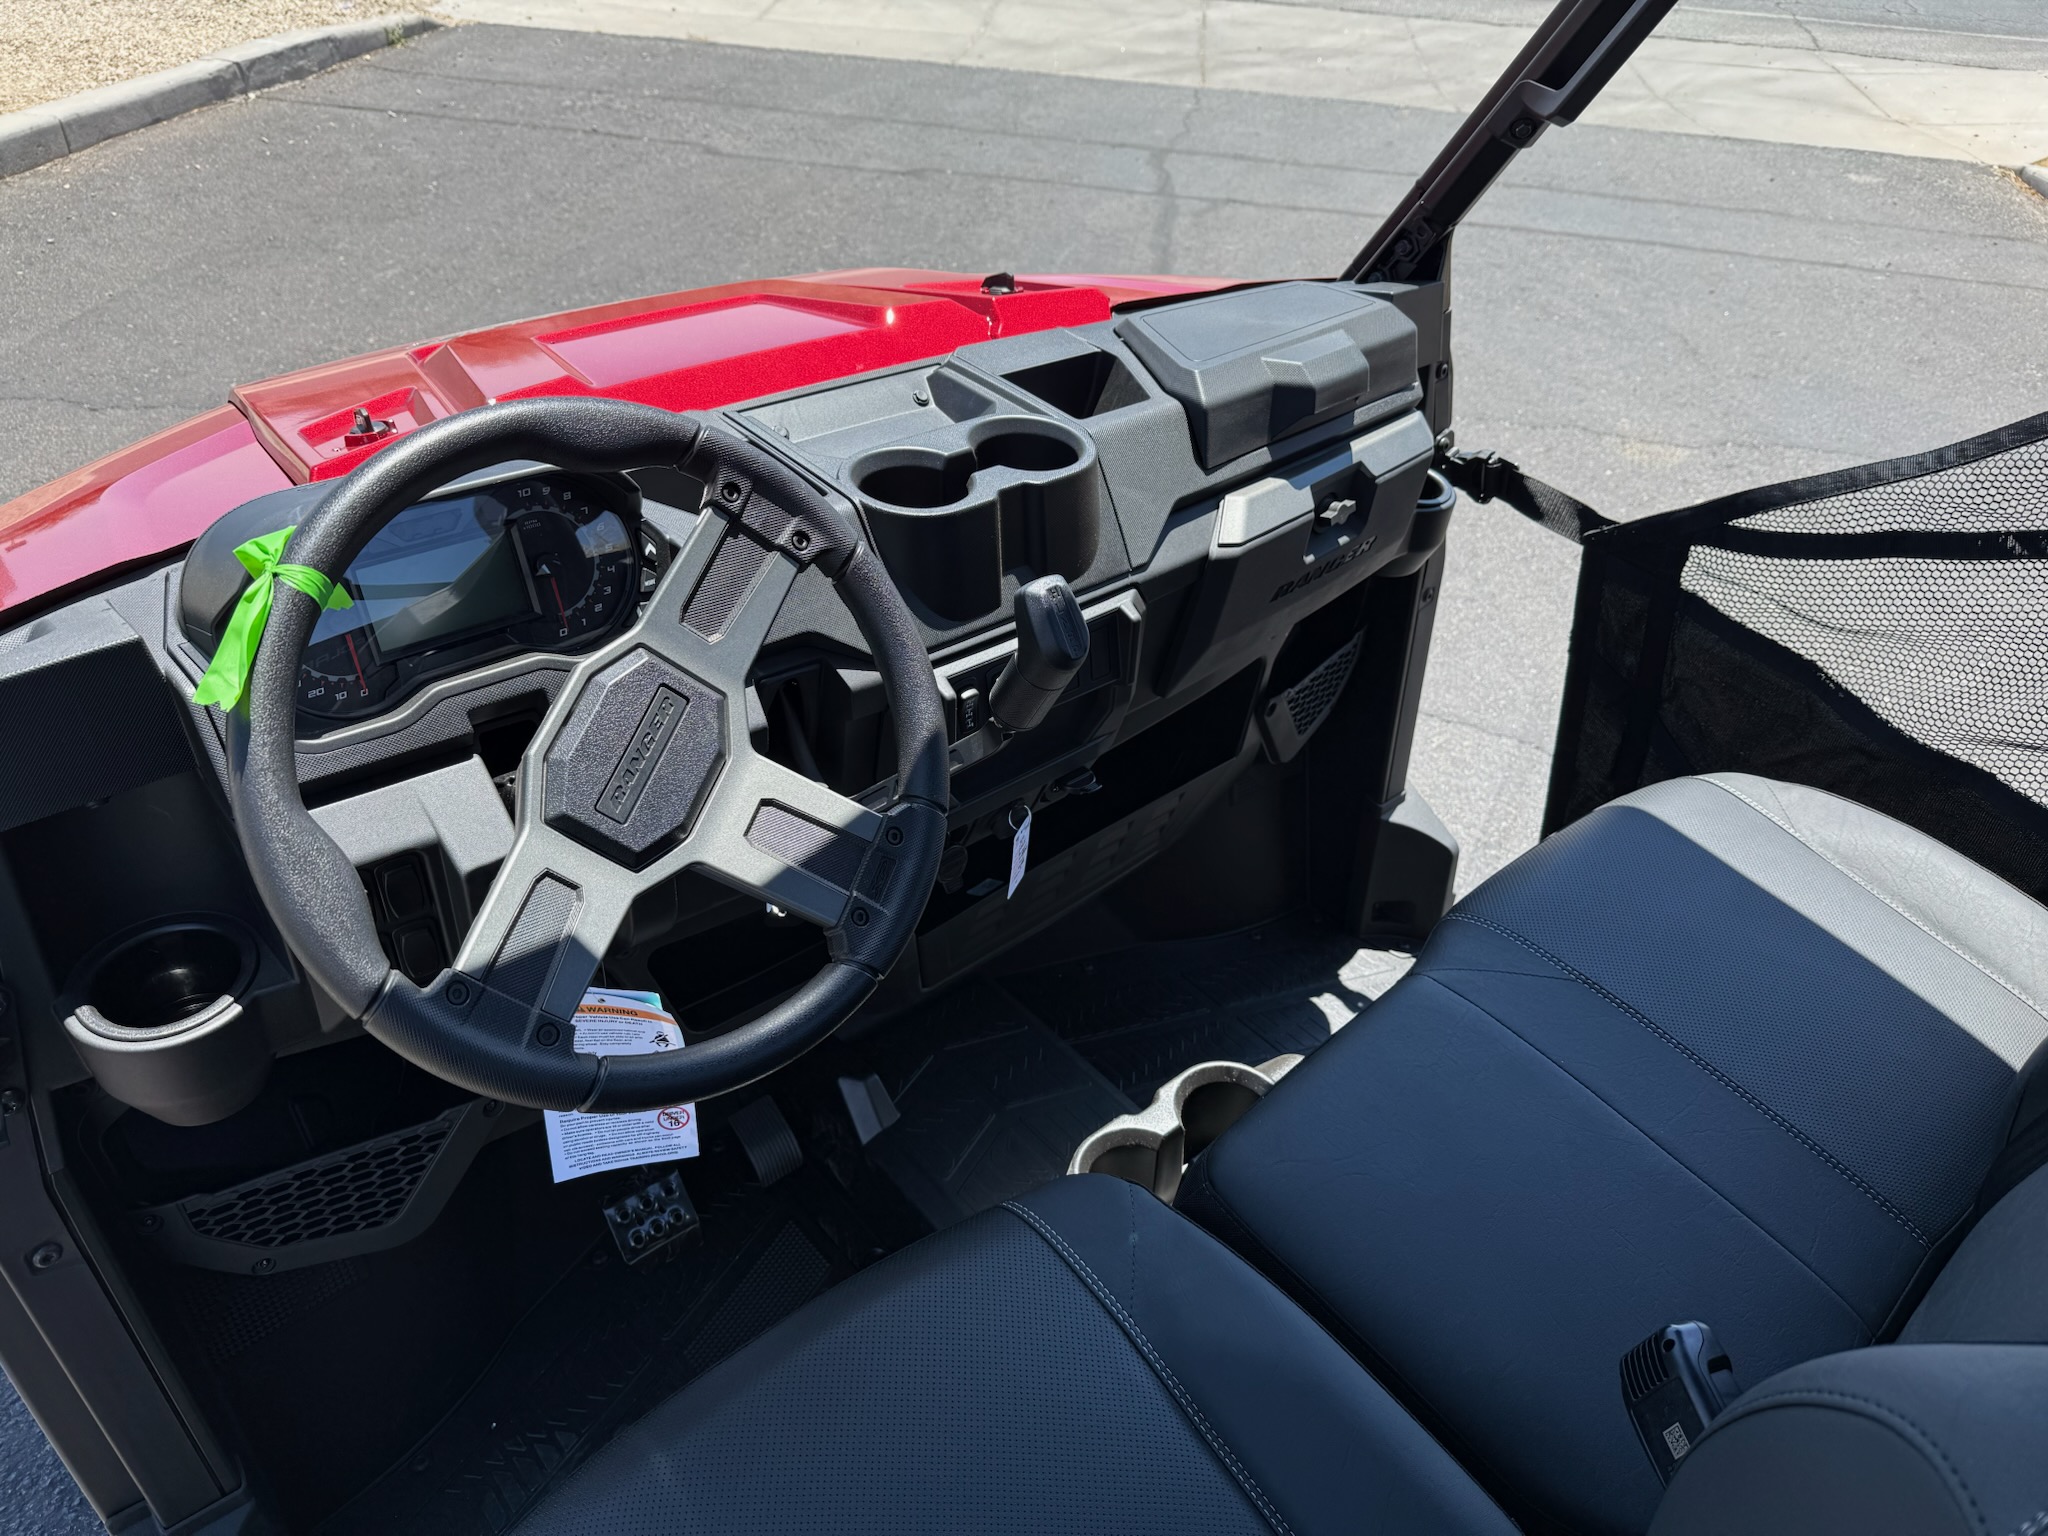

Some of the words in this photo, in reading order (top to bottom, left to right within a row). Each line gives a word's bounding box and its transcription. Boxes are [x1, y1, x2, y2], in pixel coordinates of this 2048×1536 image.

[518, 488, 531, 498] 10
[542, 487, 550, 495] 9
[563, 492, 571, 500] 8
[580, 506, 588, 514] 7
[597, 522, 604, 530] 6
[607, 565, 615, 573] 4
[1269, 536, 1377, 603] RANGER
[603, 586, 611, 595] 3
[594, 603, 602, 612] 2
[560, 628, 568, 637] 0
[308, 687, 324, 698] 20
[334, 691, 347, 700] 10
[360, 688, 368, 697] 0
[610, 695, 675, 814] RANGER
[586, 1006, 637, 1015] WARNING
[668, 1118, 680, 1127] 16
